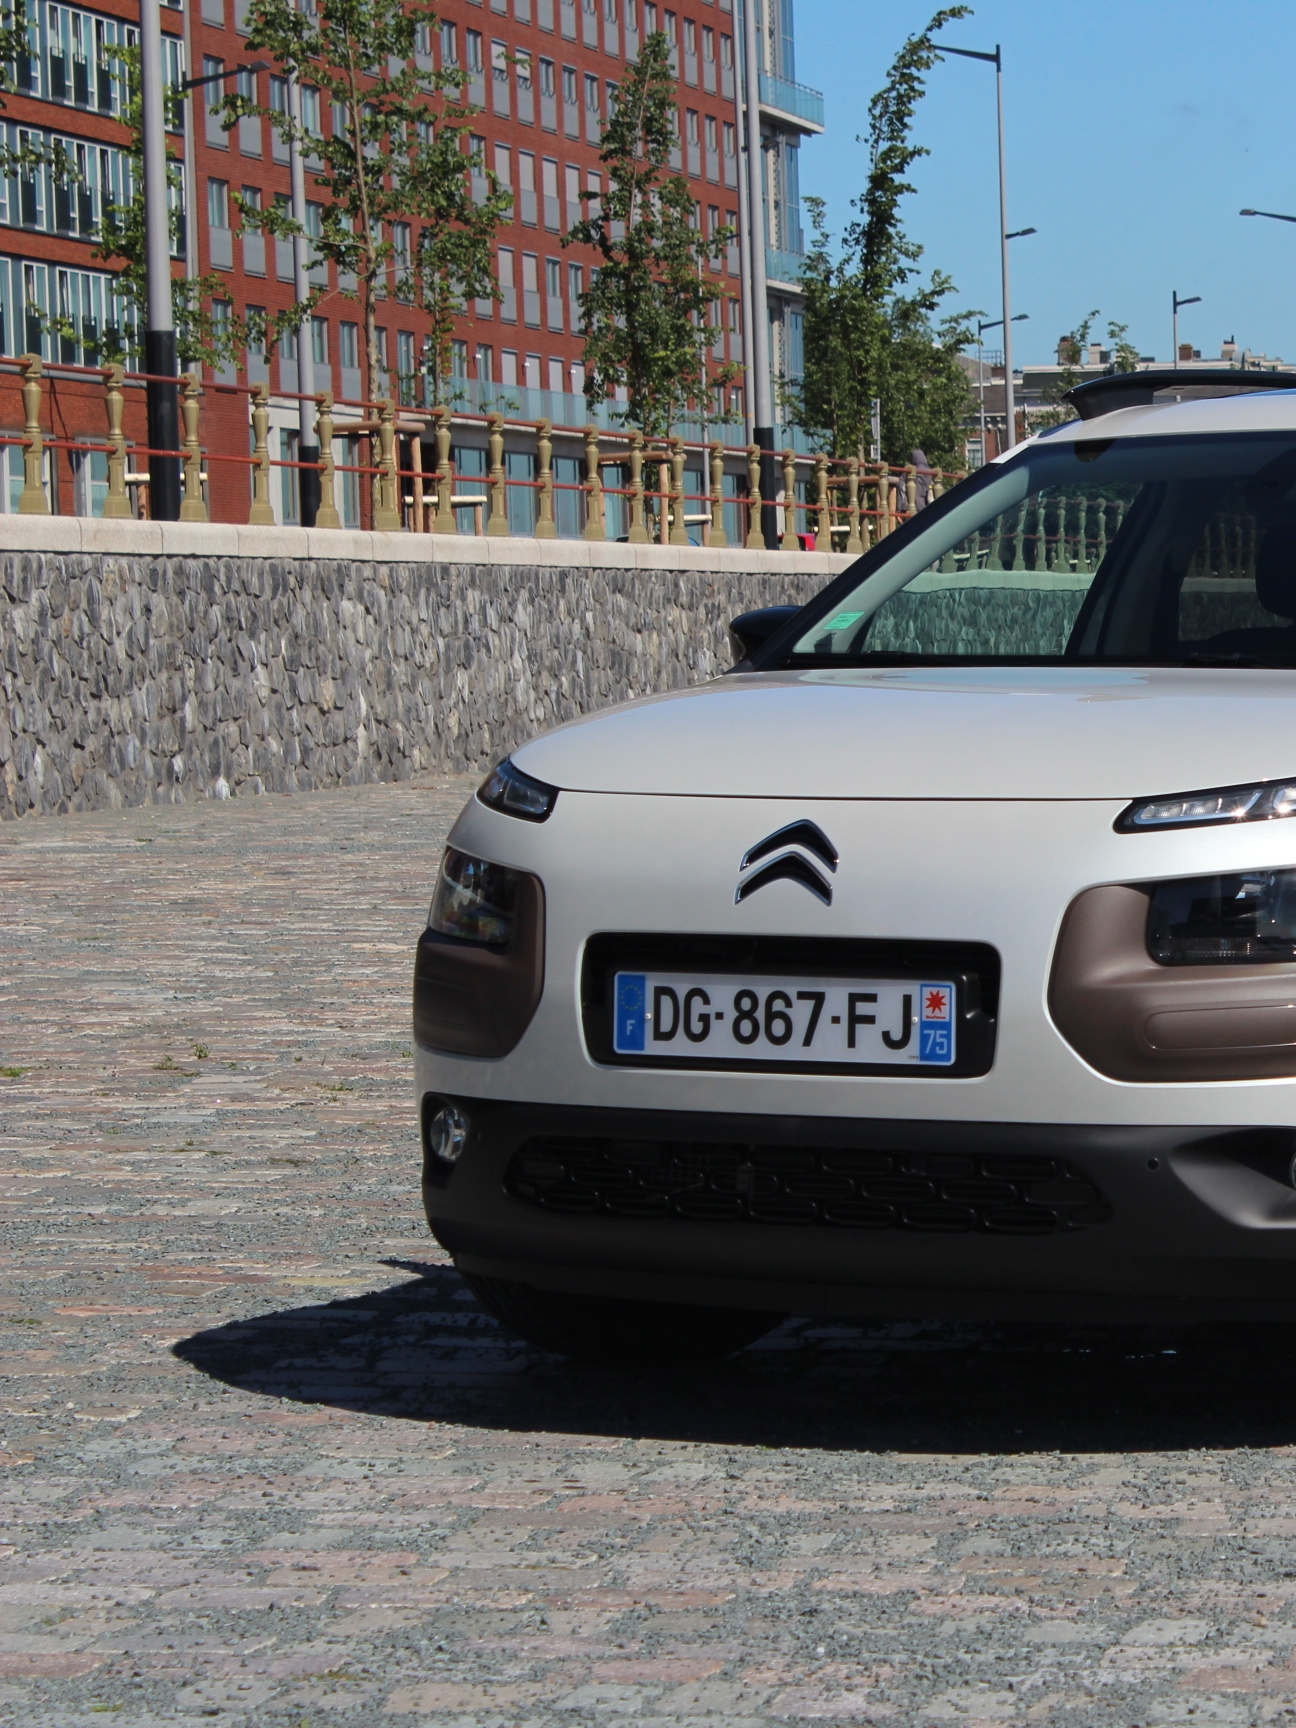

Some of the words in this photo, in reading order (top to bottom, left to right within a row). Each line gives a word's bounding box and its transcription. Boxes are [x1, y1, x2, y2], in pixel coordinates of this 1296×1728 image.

[626, 1019, 636, 1036] F
[652, 985, 913, 1051] DG-867-FJ
[923, 1029, 948, 1055] 75
